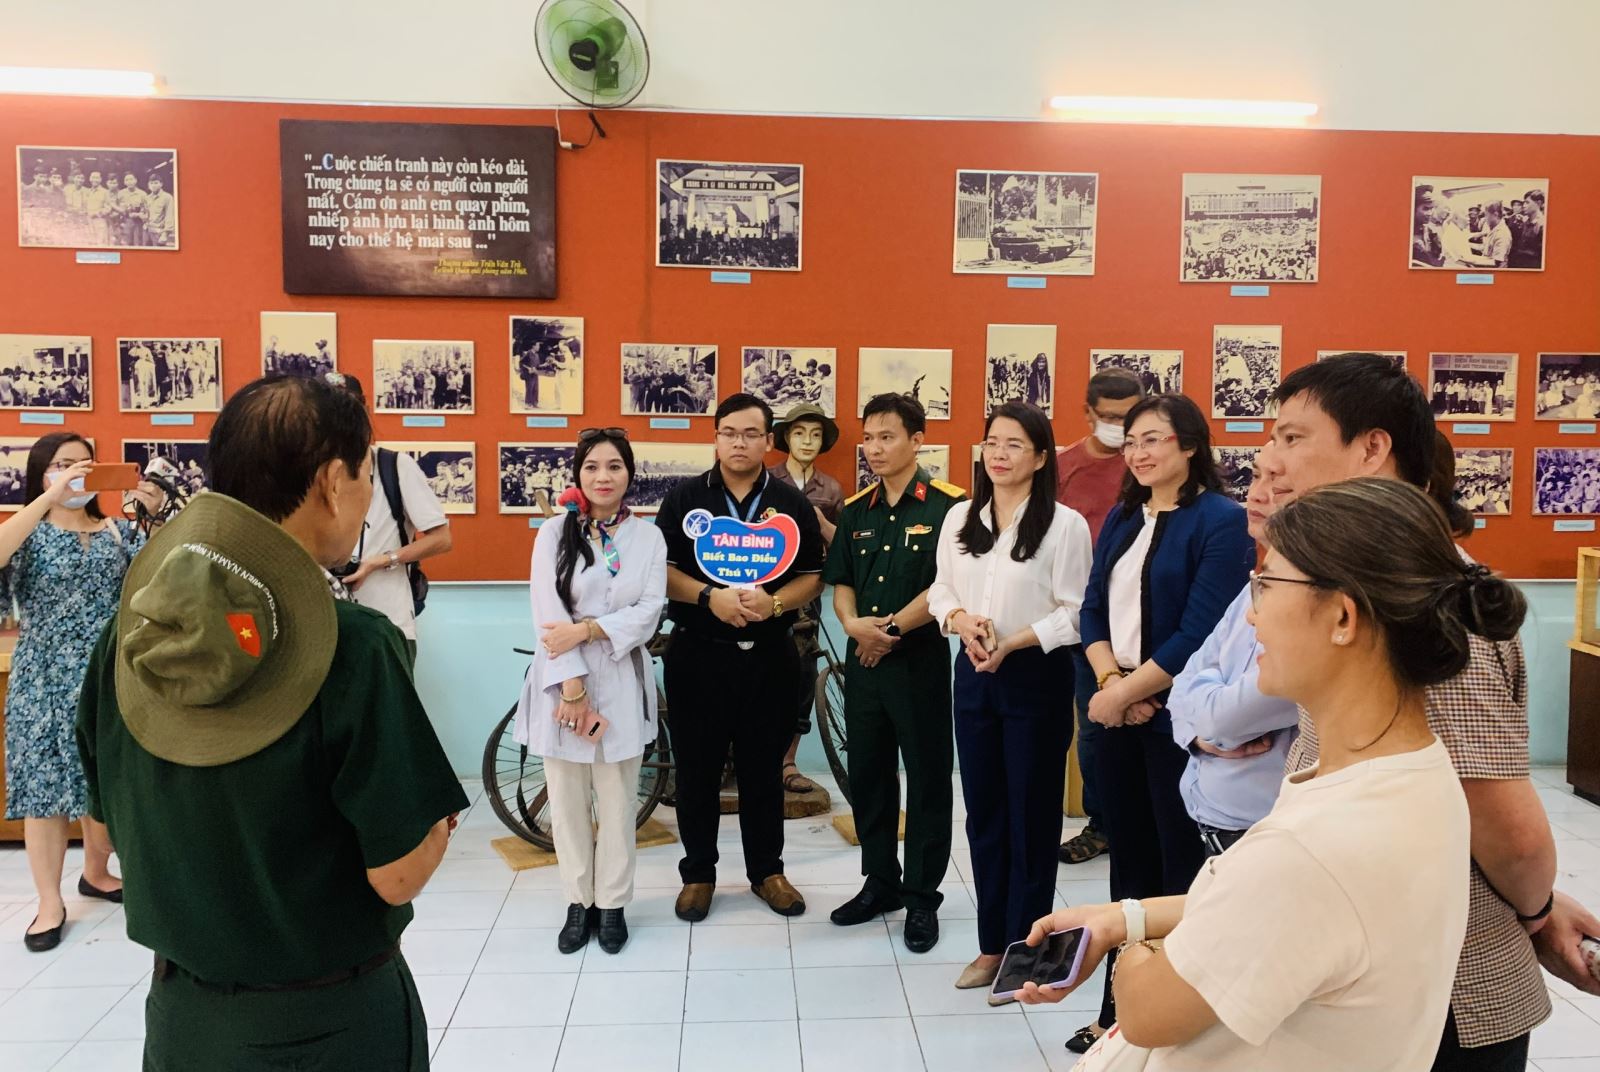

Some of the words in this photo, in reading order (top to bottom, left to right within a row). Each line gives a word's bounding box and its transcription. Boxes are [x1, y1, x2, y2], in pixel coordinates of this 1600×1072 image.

[359, 154, 392, 172] chiến
[395, 158, 429, 172] tranh
[432, 159, 454, 176] này
[456, 158, 478, 174] còn
[481, 158, 504, 174] kéo
[506, 159, 528, 176] dài.
[304, 173, 343, 194] Trong
[345, 174, 382, 194] chúng
[384, 176, 398, 191] ta
[416, 174, 430, 192] có
[434, 176, 468, 196] người
[470, 176, 492, 193] còn
[494, 178, 528, 198] người
[308, 190, 340, 209] mất.
[342, 192, 376, 210] Cám
[380, 195, 398, 211] ơn
[400, 194, 428, 212] anh
[430, 198, 452, 212] em
[456, 199, 488, 216] quay
[492, 198, 530, 216] phim,
[308, 209, 350, 231] nhiếp
[352, 212, 380, 228] ảnh
[384, 213, 407, 230] lưu
[410, 214, 428, 234] lại
[432, 214, 464, 230] hình
[468, 214, 496, 231] ảnh
[500, 216, 530, 232] hôm
[309, 233, 334, 250] nay
[338, 231, 364, 247] cho
[368, 230, 392, 248] thế
[396, 232, 412, 251] hệ
[418, 233, 444, 248] mai
[448, 236, 472, 249] sau
[712, 533, 739, 547] TÂN
[742, 534, 773, 548] BÌNH
[218, 556, 242, 574] NAM
[702, 551, 724, 561] Biết
[728, 553, 748, 562] Bao
[717, 567, 740, 577] Thú
